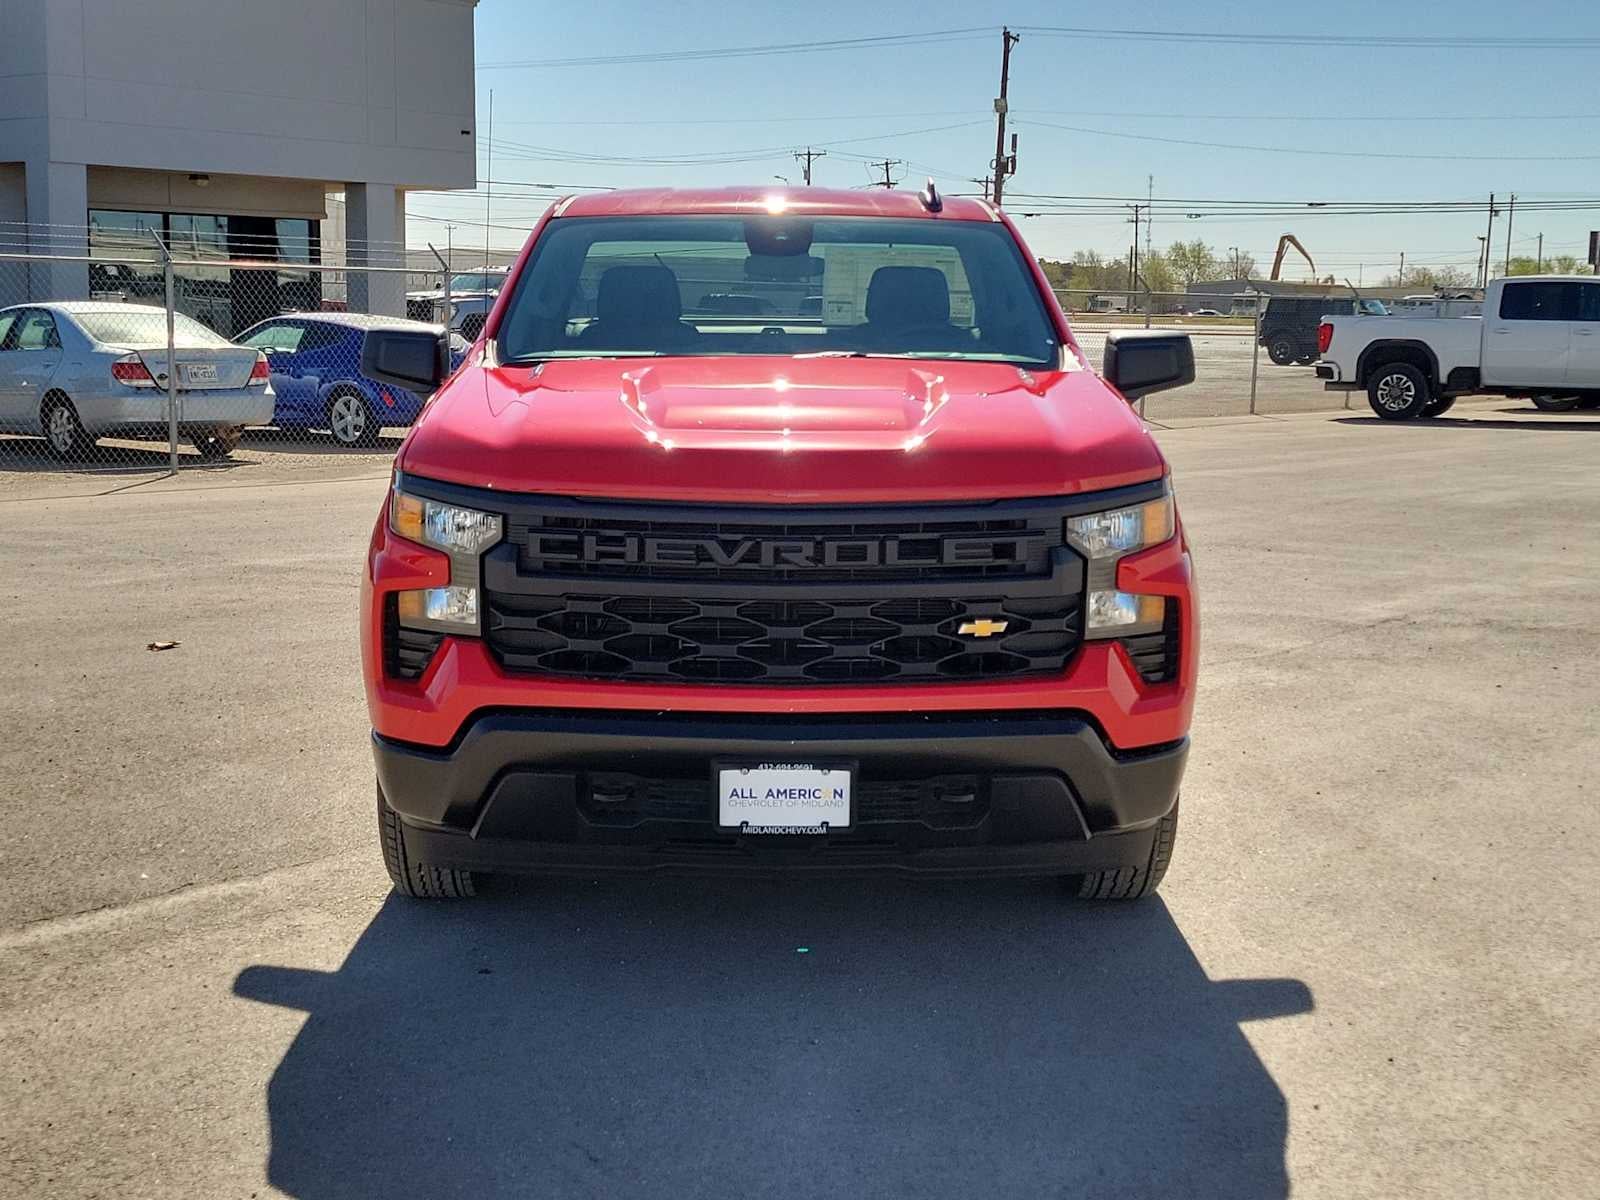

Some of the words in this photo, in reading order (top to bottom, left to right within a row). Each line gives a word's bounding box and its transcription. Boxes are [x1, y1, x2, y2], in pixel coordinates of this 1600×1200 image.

[527, 530, 1043, 569] CHEVROLET
[729, 788, 757, 799] ALL
[728, 800, 783, 808] CHEVROLET
[786, 800, 798, 808] OF
[801, 800, 844, 808] MIDLAND
[742, 825, 827, 835] MIDLANDCHEVY.COM
